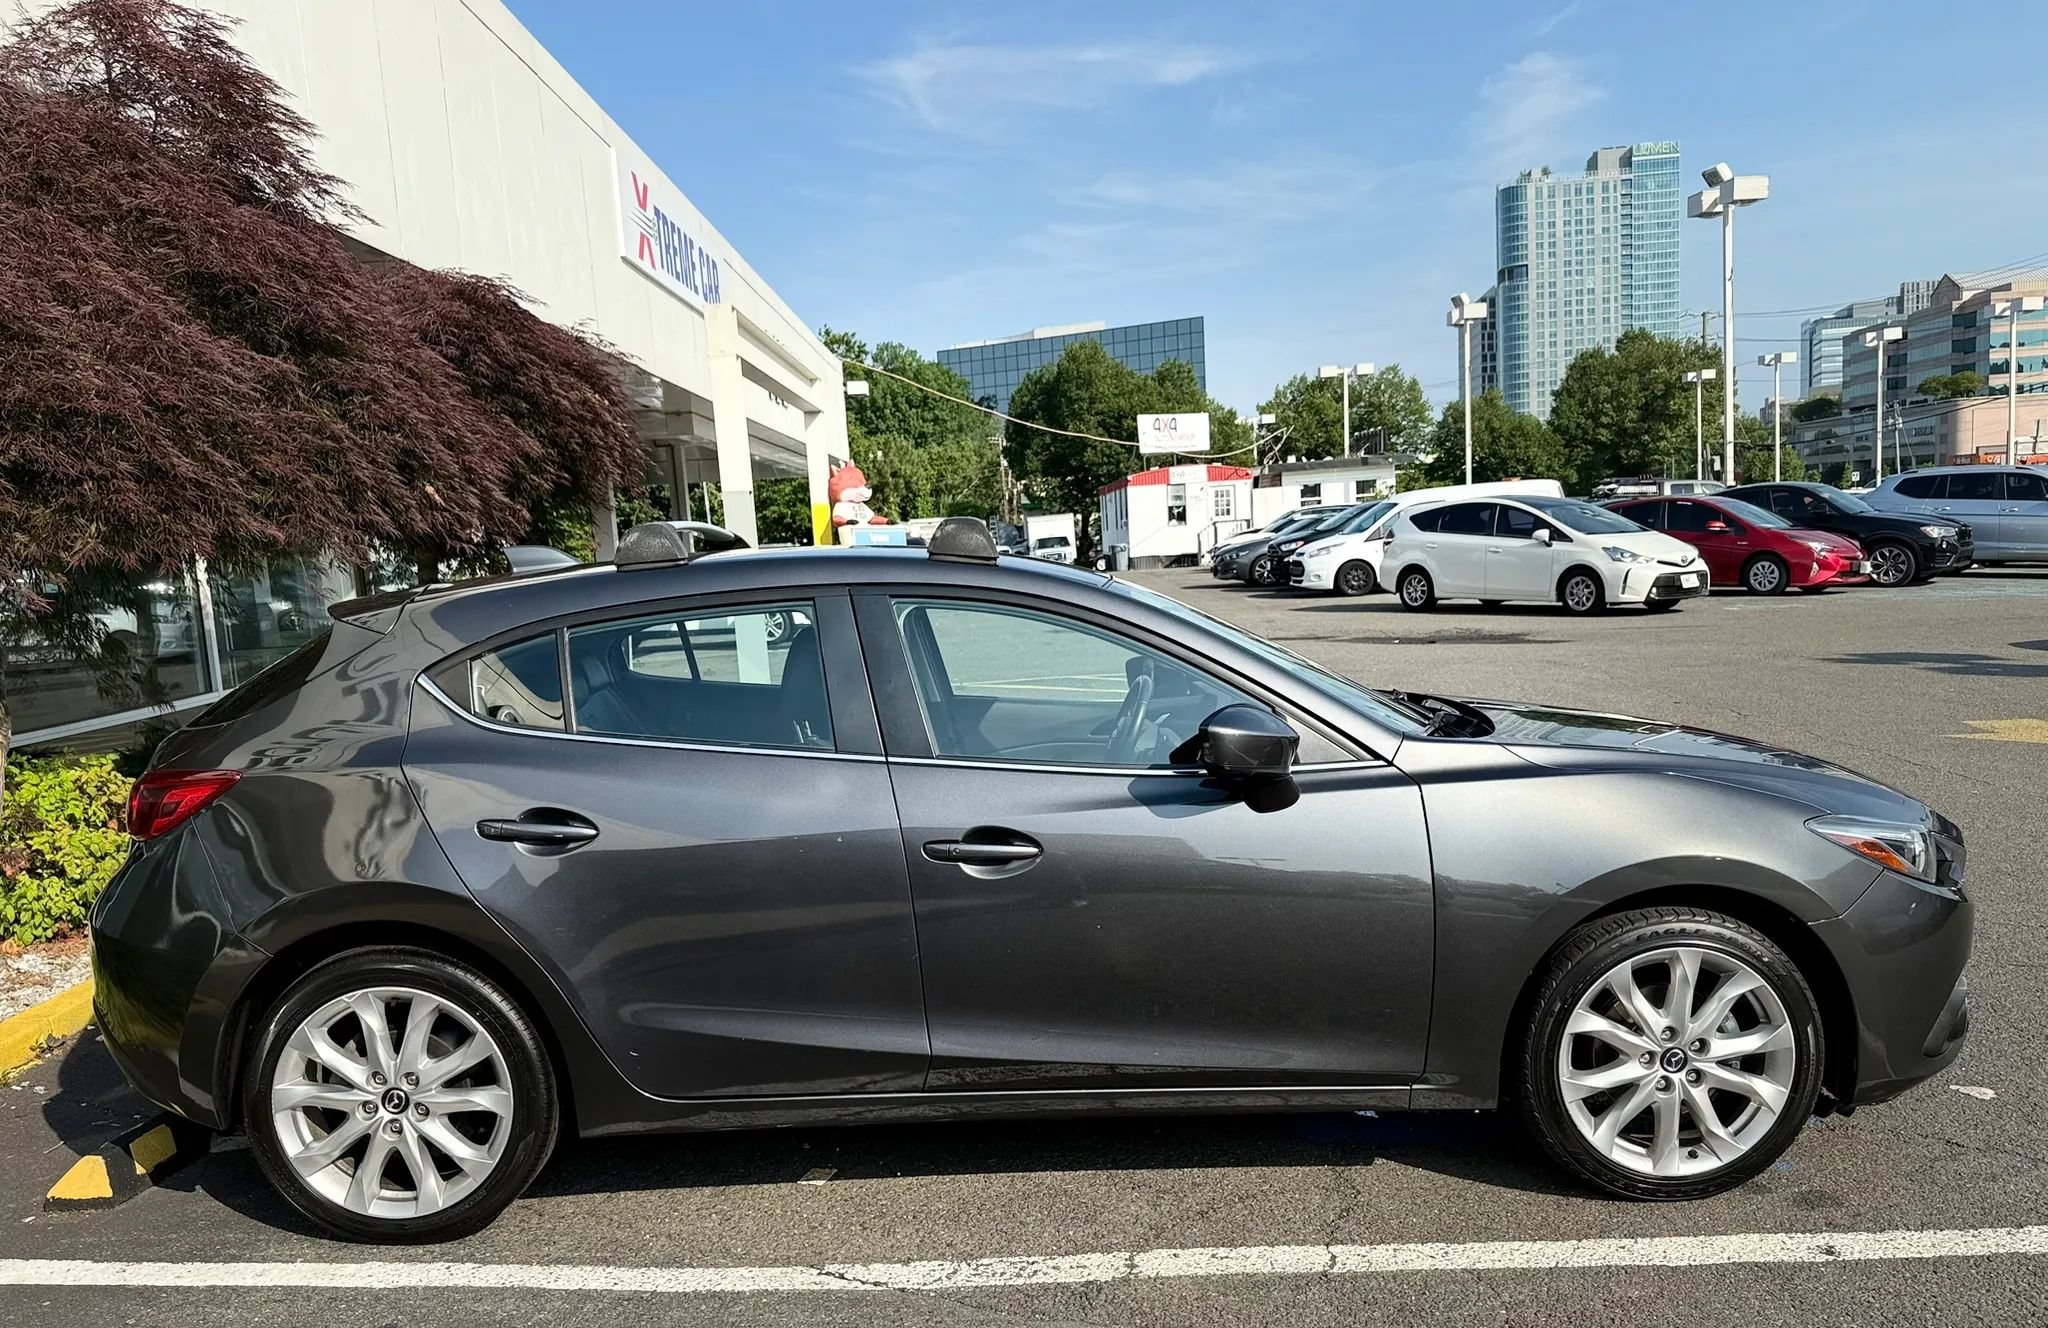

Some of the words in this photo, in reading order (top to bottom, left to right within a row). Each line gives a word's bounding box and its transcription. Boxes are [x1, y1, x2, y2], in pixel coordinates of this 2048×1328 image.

[1632, 140, 1680, 155] LUMEN
[698, 246, 721, 305] CAR
[1635, 927, 1707, 942] EAGLE
